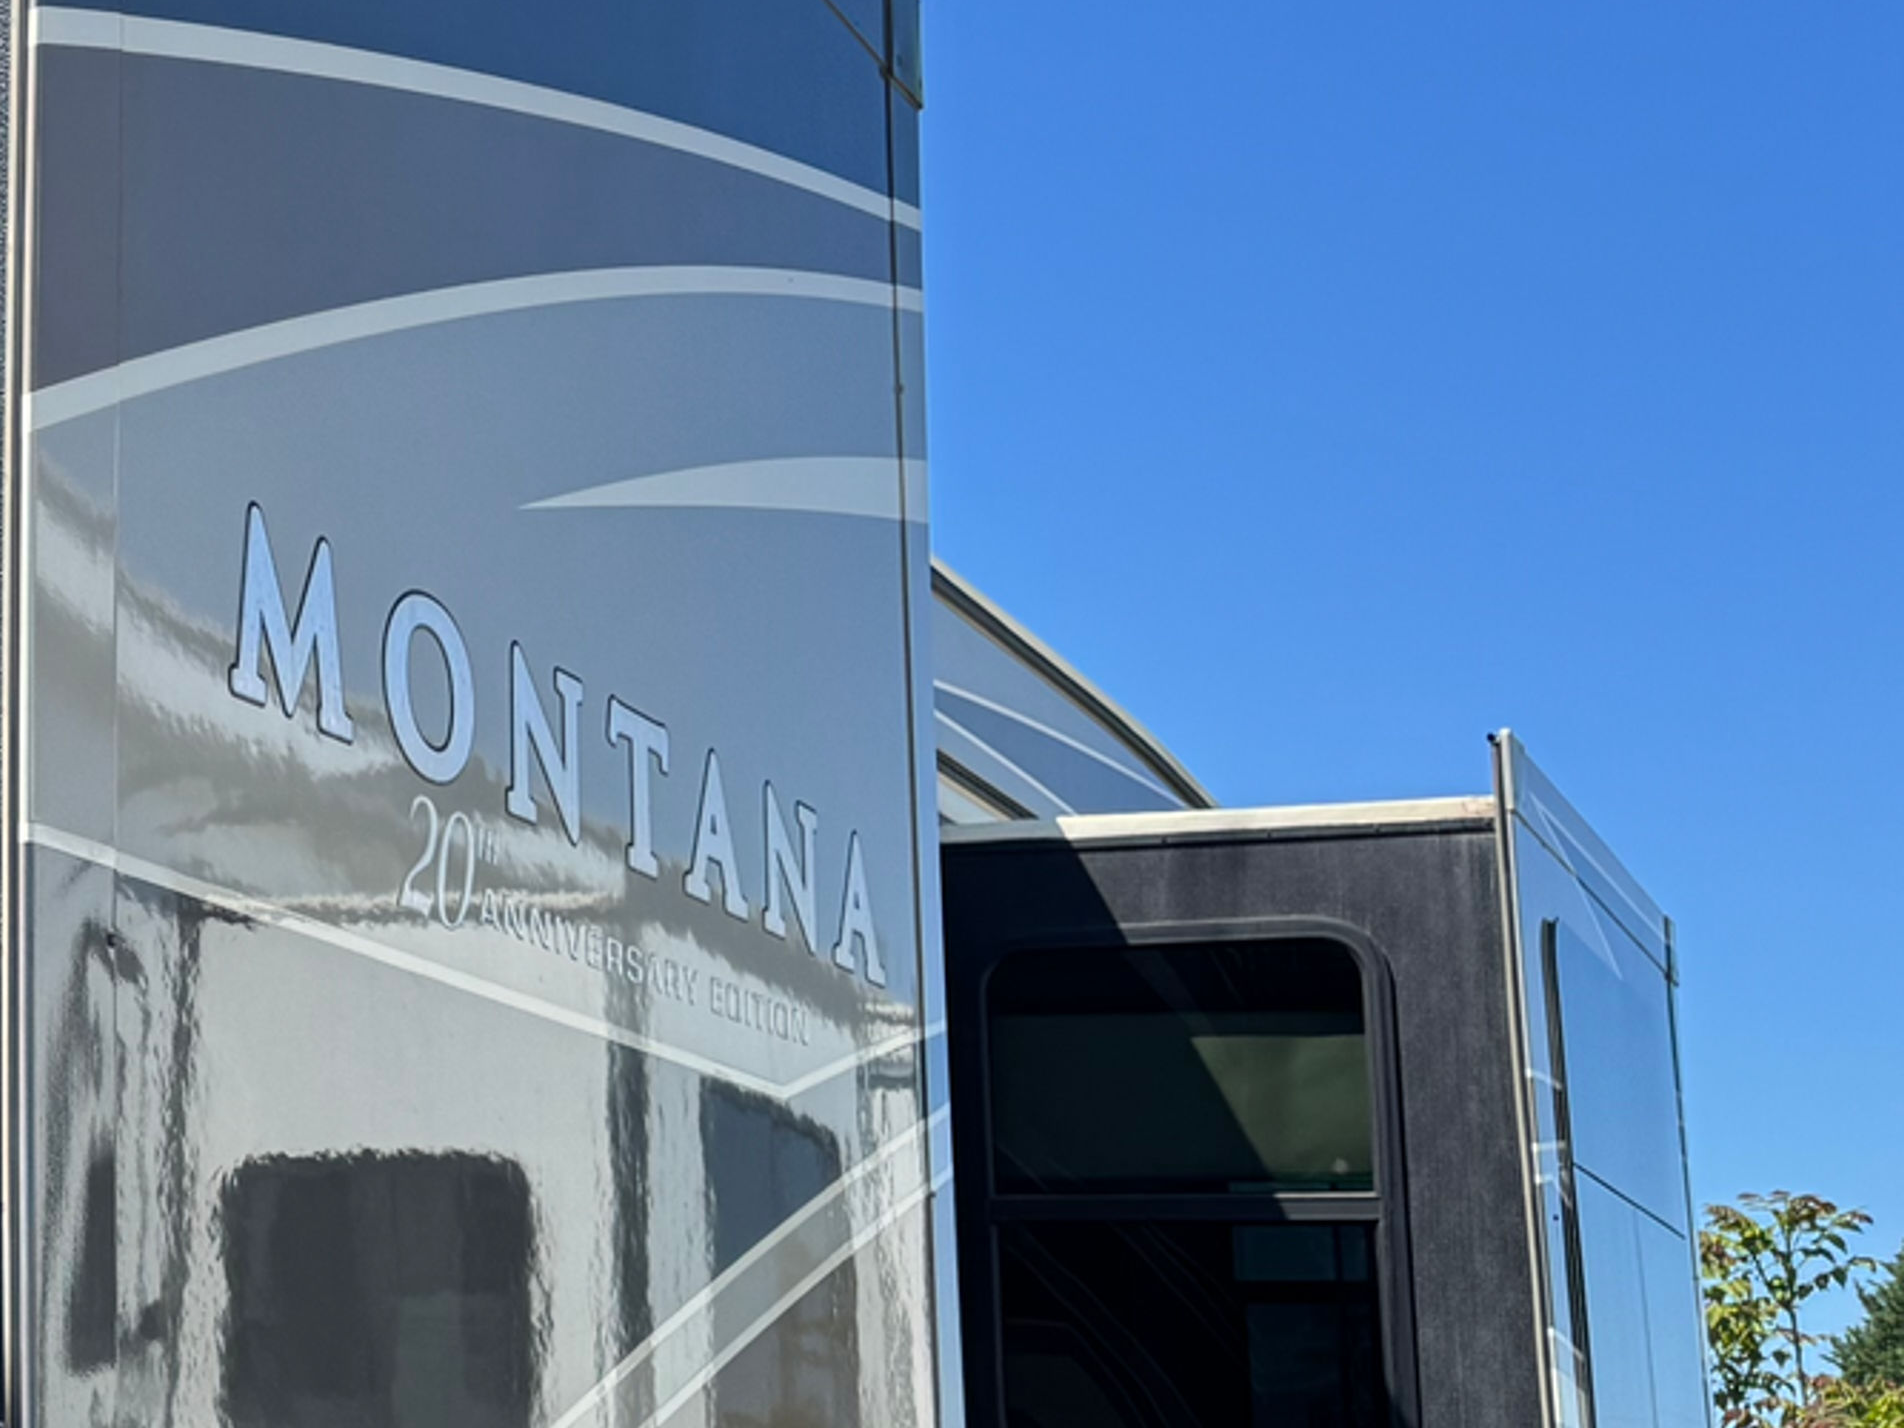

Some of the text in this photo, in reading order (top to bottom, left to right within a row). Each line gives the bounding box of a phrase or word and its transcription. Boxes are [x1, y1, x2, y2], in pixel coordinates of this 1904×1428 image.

[229, 502, 885, 987] MONTANA
[481, 890, 810, 1048] ANNIVERSARY EDITION
